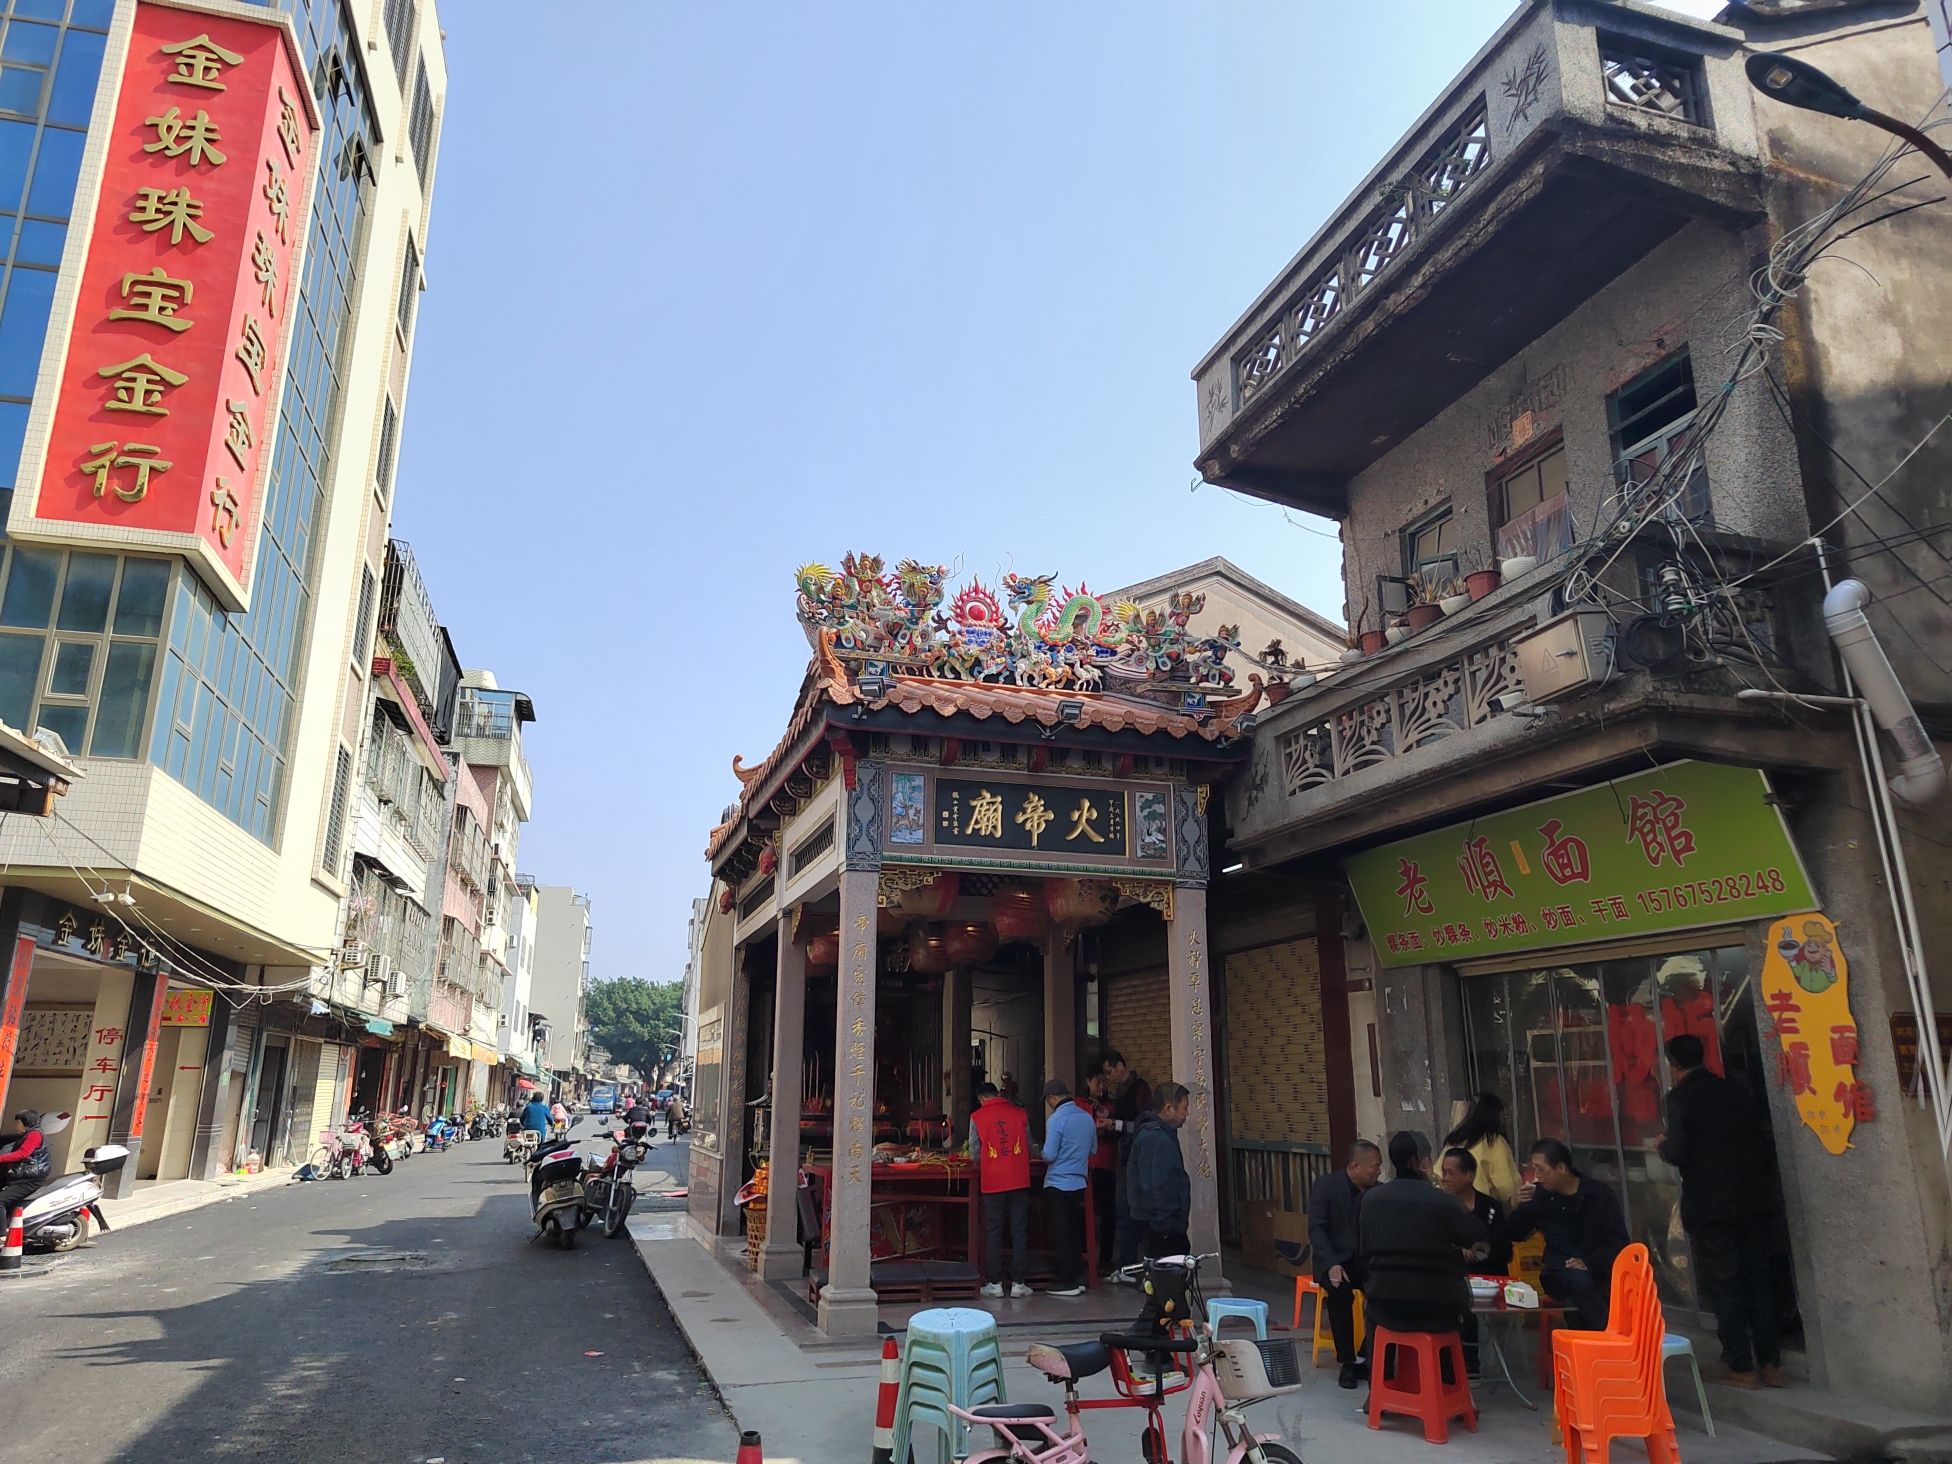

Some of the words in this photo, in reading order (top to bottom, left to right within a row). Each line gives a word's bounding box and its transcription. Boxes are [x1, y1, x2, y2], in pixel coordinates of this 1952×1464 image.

[80, 34, 243, 502] 金妹珠宝金行
[210, 86, 301, 548] 金妹珠宝金行
[1396, 789, 1697, 918] 老順面館
[1636, 867, 1787, 915] 15767528248
[83, 1026, 124, 1102] 停车厅
